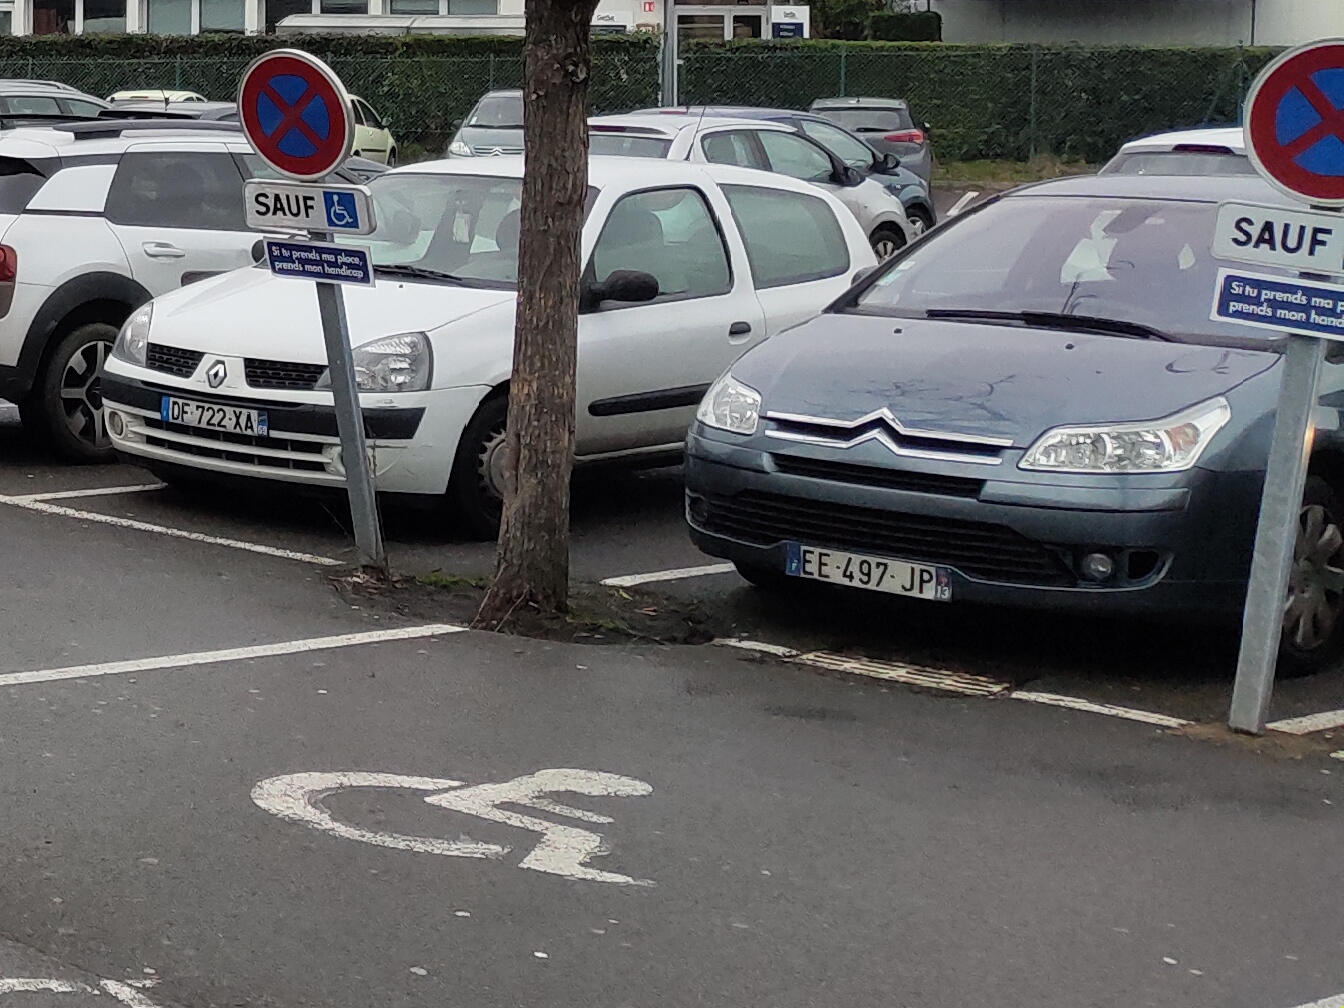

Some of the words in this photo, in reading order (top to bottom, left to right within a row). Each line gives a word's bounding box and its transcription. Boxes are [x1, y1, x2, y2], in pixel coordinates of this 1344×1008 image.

[254, 192, 316, 219] SAUF
[1231, 217, 1333, 256] SAUF
[272, 245, 280, 256] Si
[282, 248, 290, 257] tu
[292, 249, 320, 262] prends
[322, 253, 335, 262] ma
[337, 252, 363, 267] place,
[274, 260, 303, 272] prends
[305, 264, 323, 274] mon
[324, 263, 364, 279] handicap
[1230, 281, 1244, 295] Si
[1244, 285, 1258, 297] tu
[1260, 289, 1309, 305] prends
[1311, 297, 1333, 309] ma
[1228, 301, 1273, 317] prends
[1276, 308, 1307, 322] mon
[936, 585, 949, 599] 13
